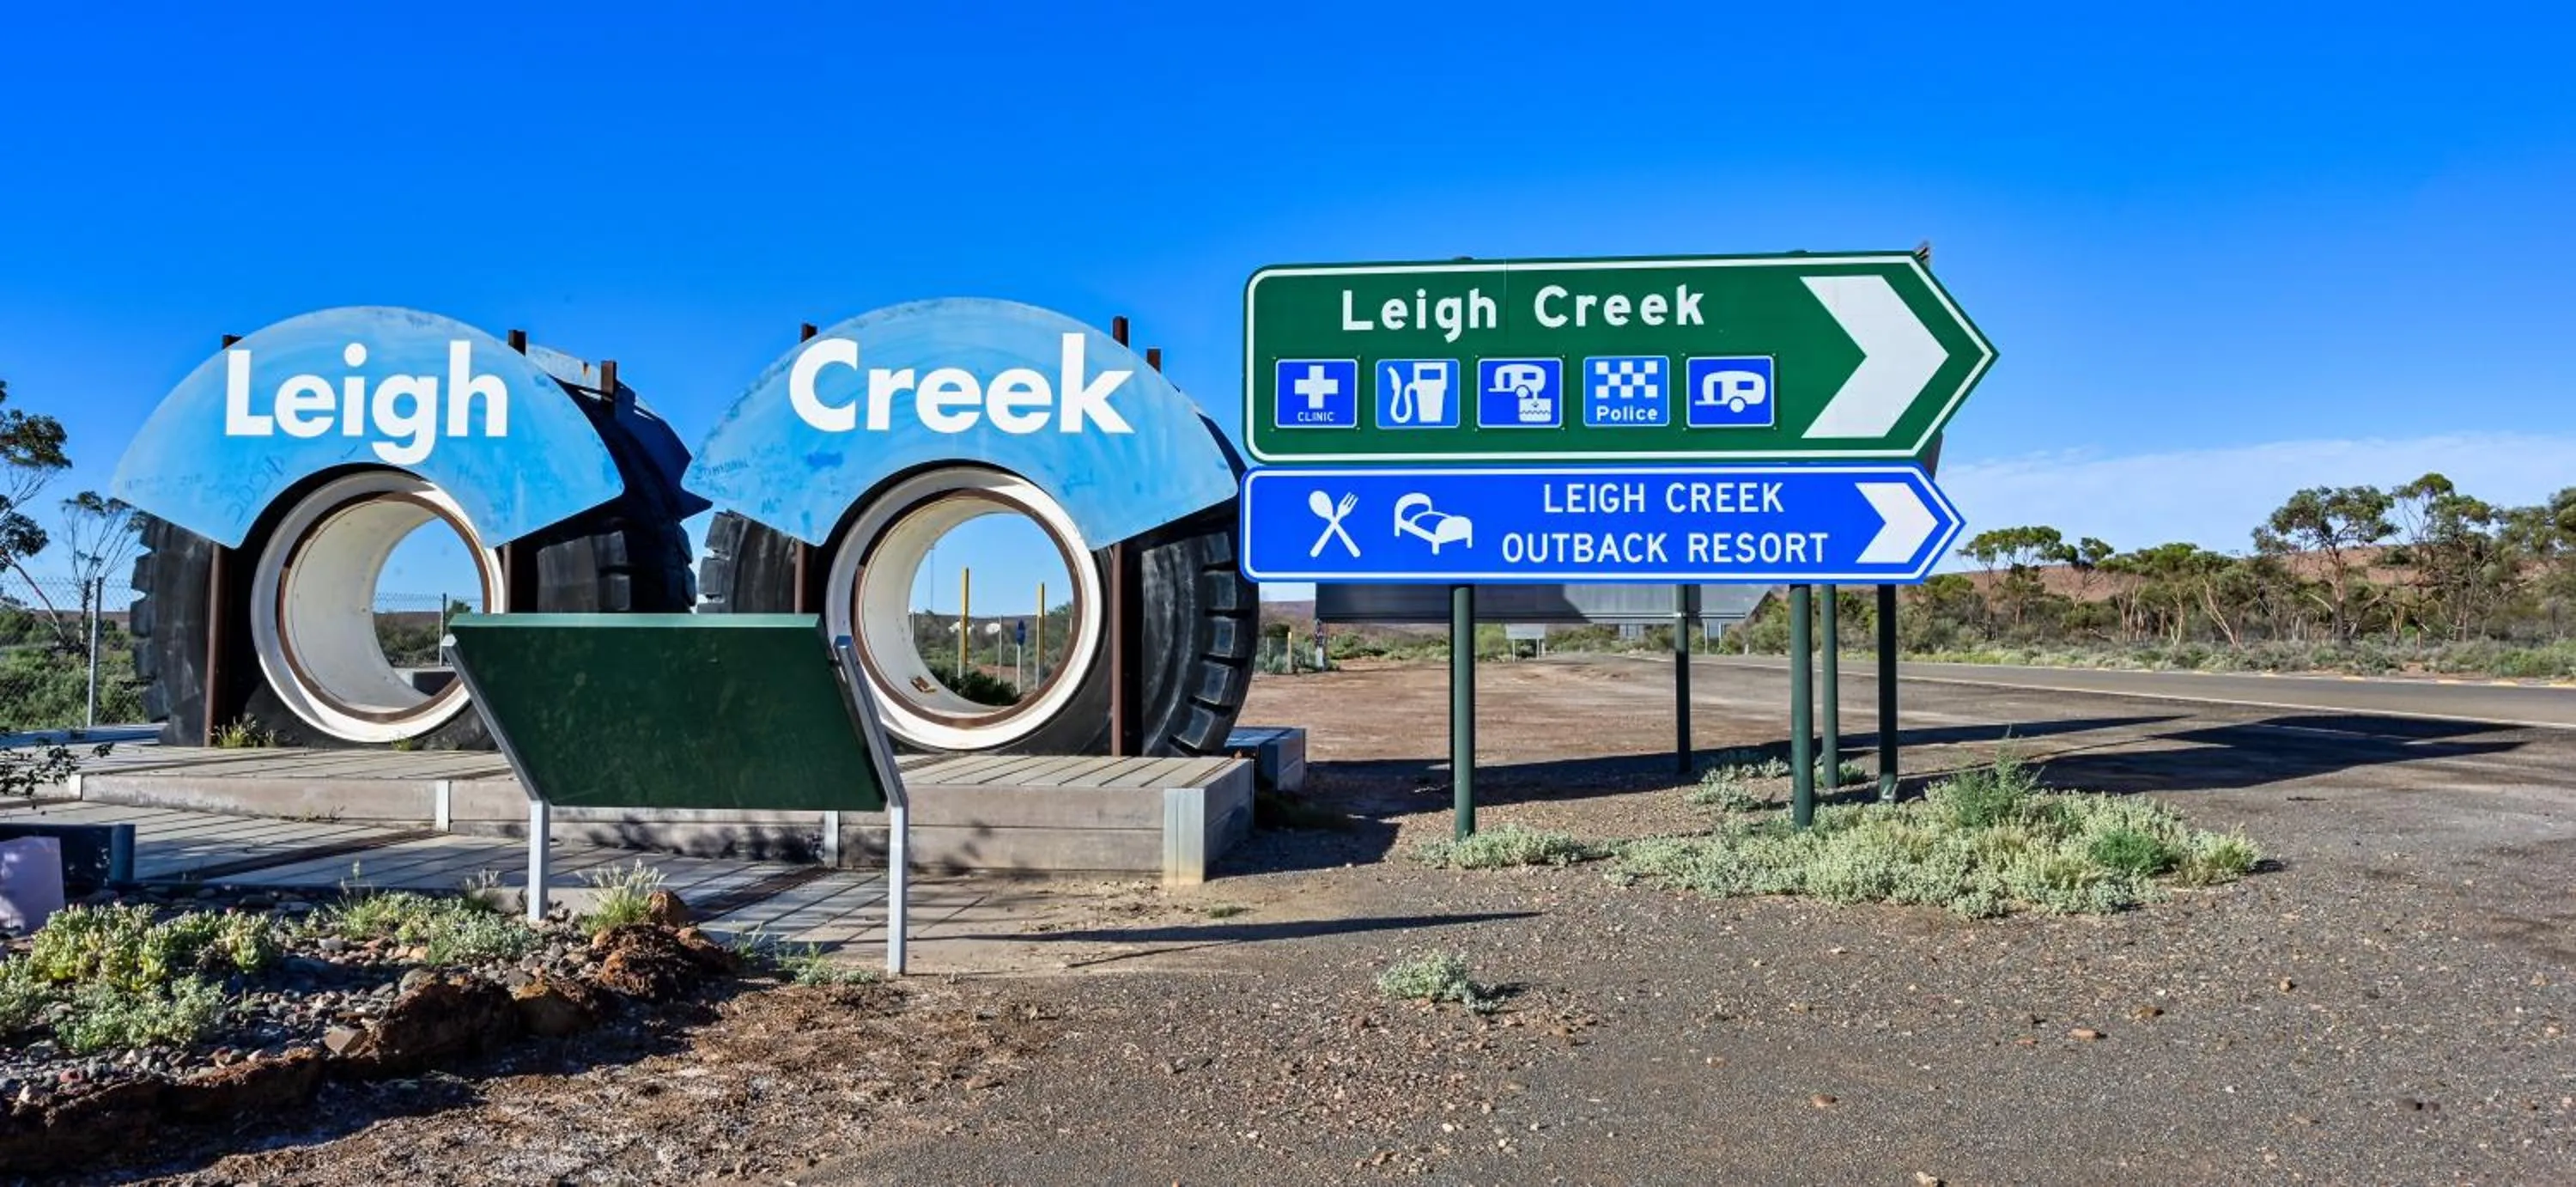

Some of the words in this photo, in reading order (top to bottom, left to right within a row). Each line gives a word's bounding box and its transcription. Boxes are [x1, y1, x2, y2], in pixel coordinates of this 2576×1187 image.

[1343, 288, 1498, 343] Leigh
[1534, 284, 1704, 328] Creek
[789, 332, 1133, 435] Creek
[224, 340, 507, 465] Leigh
[1297, 411, 1334, 422] CLINIC
[1596, 405, 1658, 421] Police
[1545, 484, 1644, 514] LEIGH
[1666, 483, 1784, 513] CREEK
[1502, 533, 1668, 563] OUTBACK
[1689, 533, 1829, 563] RESORT
